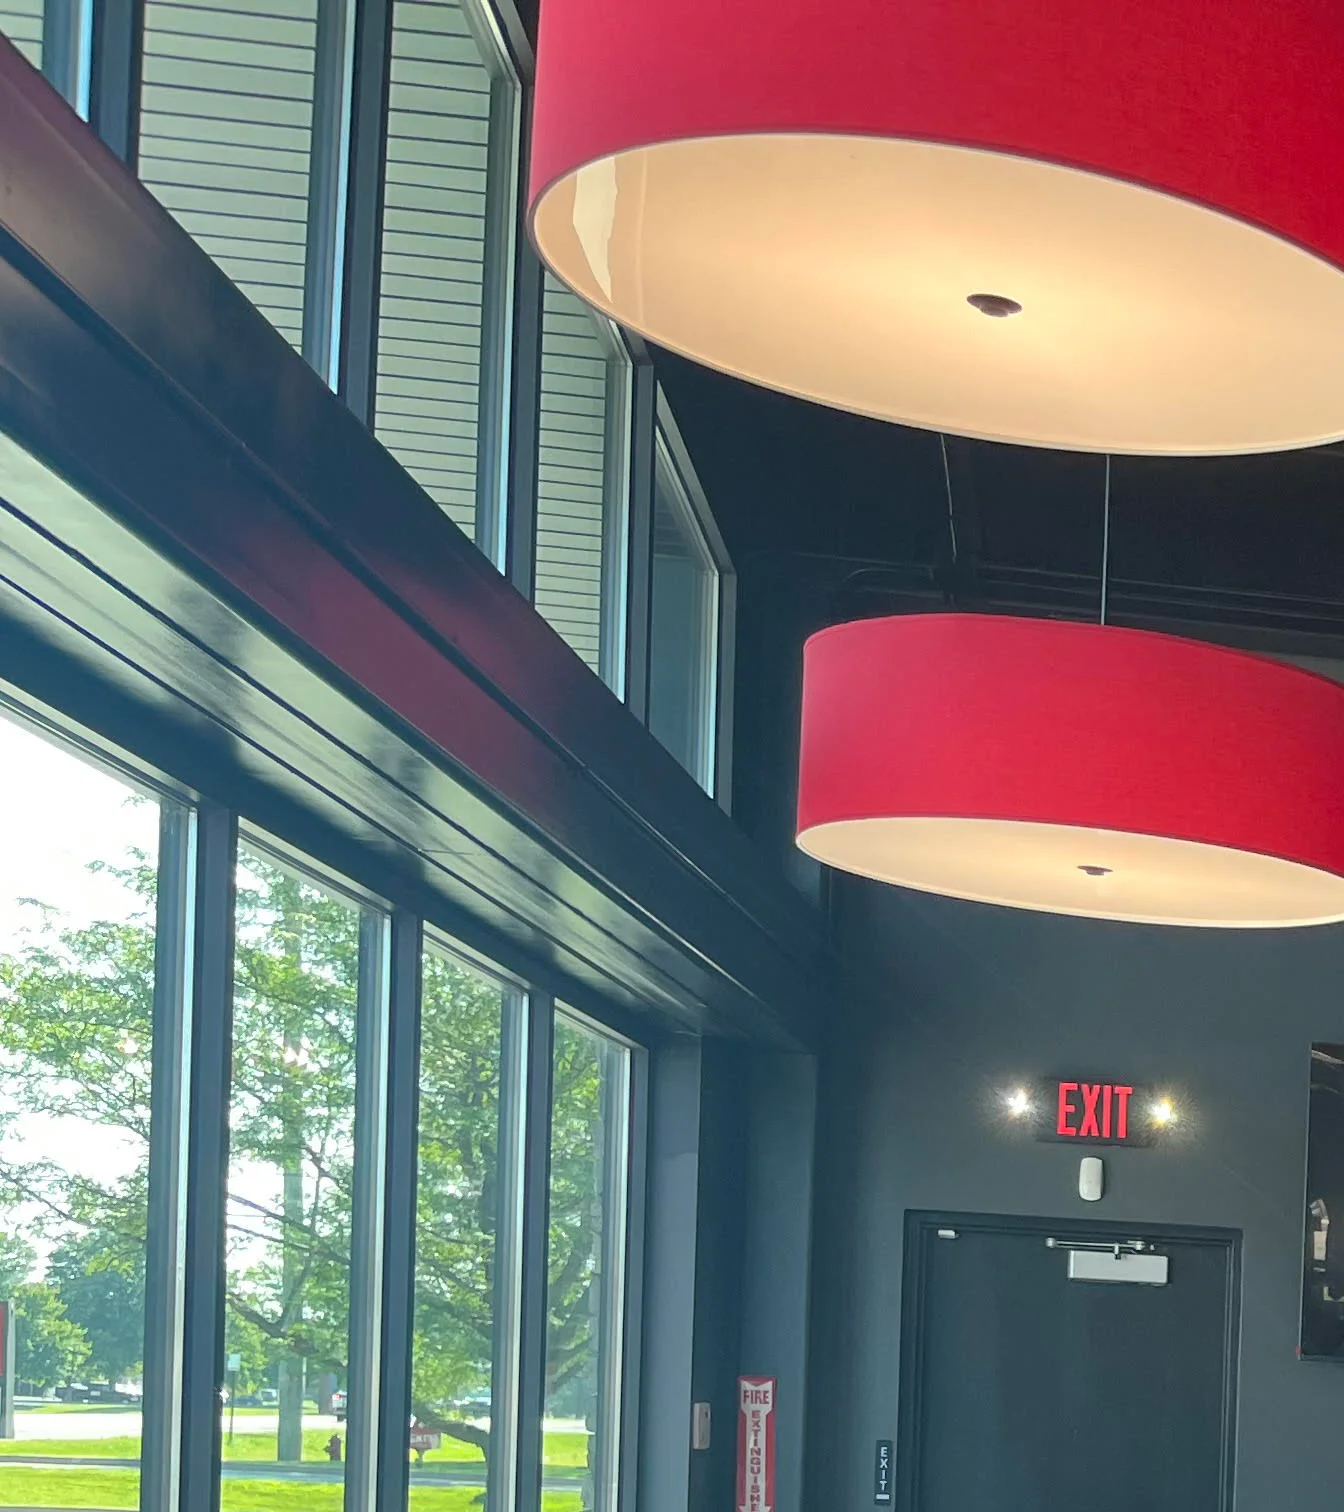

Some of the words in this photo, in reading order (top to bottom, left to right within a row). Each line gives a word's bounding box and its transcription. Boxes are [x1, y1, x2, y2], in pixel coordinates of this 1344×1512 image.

[1056, 1082, 1134, 1138] EXIT
[743, 1389, 769, 1405] FIRE
[879, 1446, 889, 1491] EXIT
